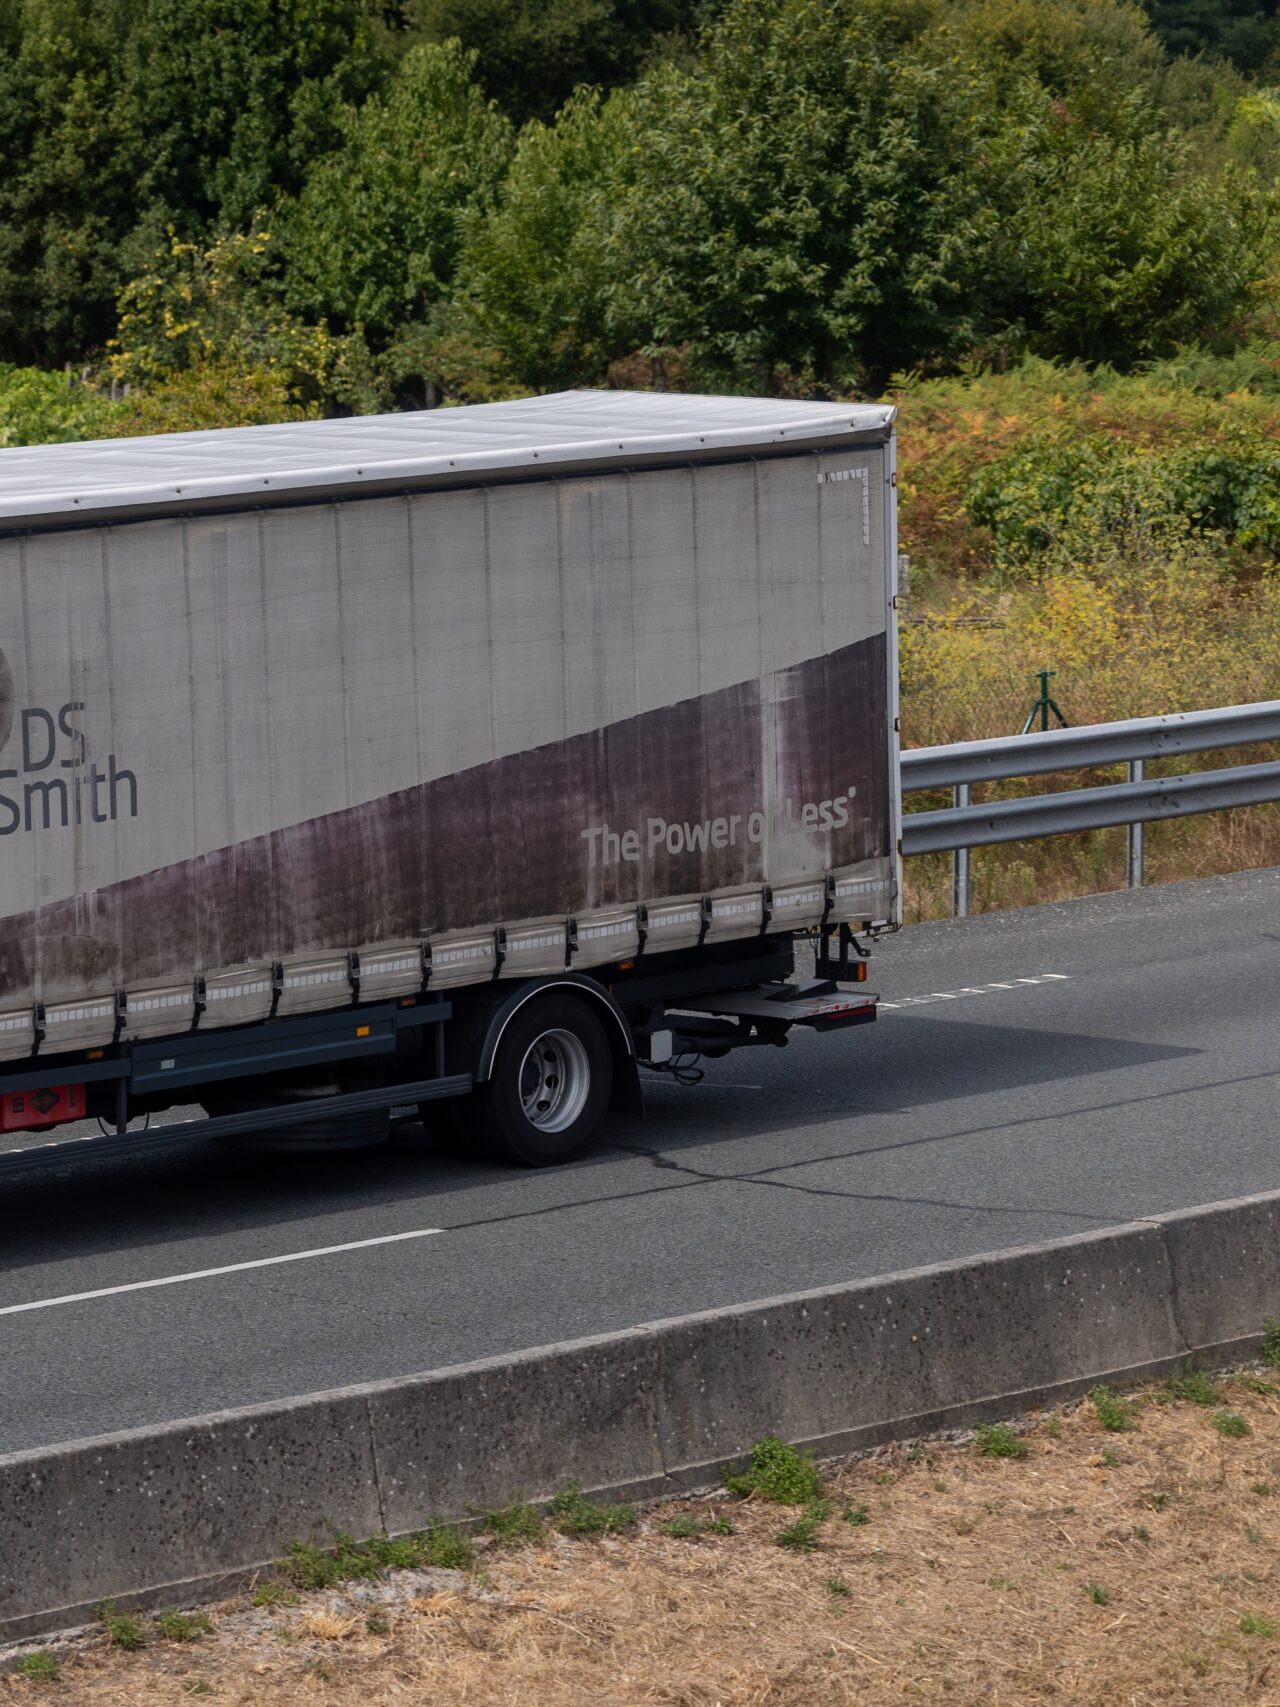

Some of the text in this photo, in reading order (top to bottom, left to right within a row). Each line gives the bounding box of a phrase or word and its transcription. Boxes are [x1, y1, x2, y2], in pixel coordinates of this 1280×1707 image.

[21, 702, 85, 773] DS
[580, 823, 640, 867] The
[647, 817, 741, 858] Power
